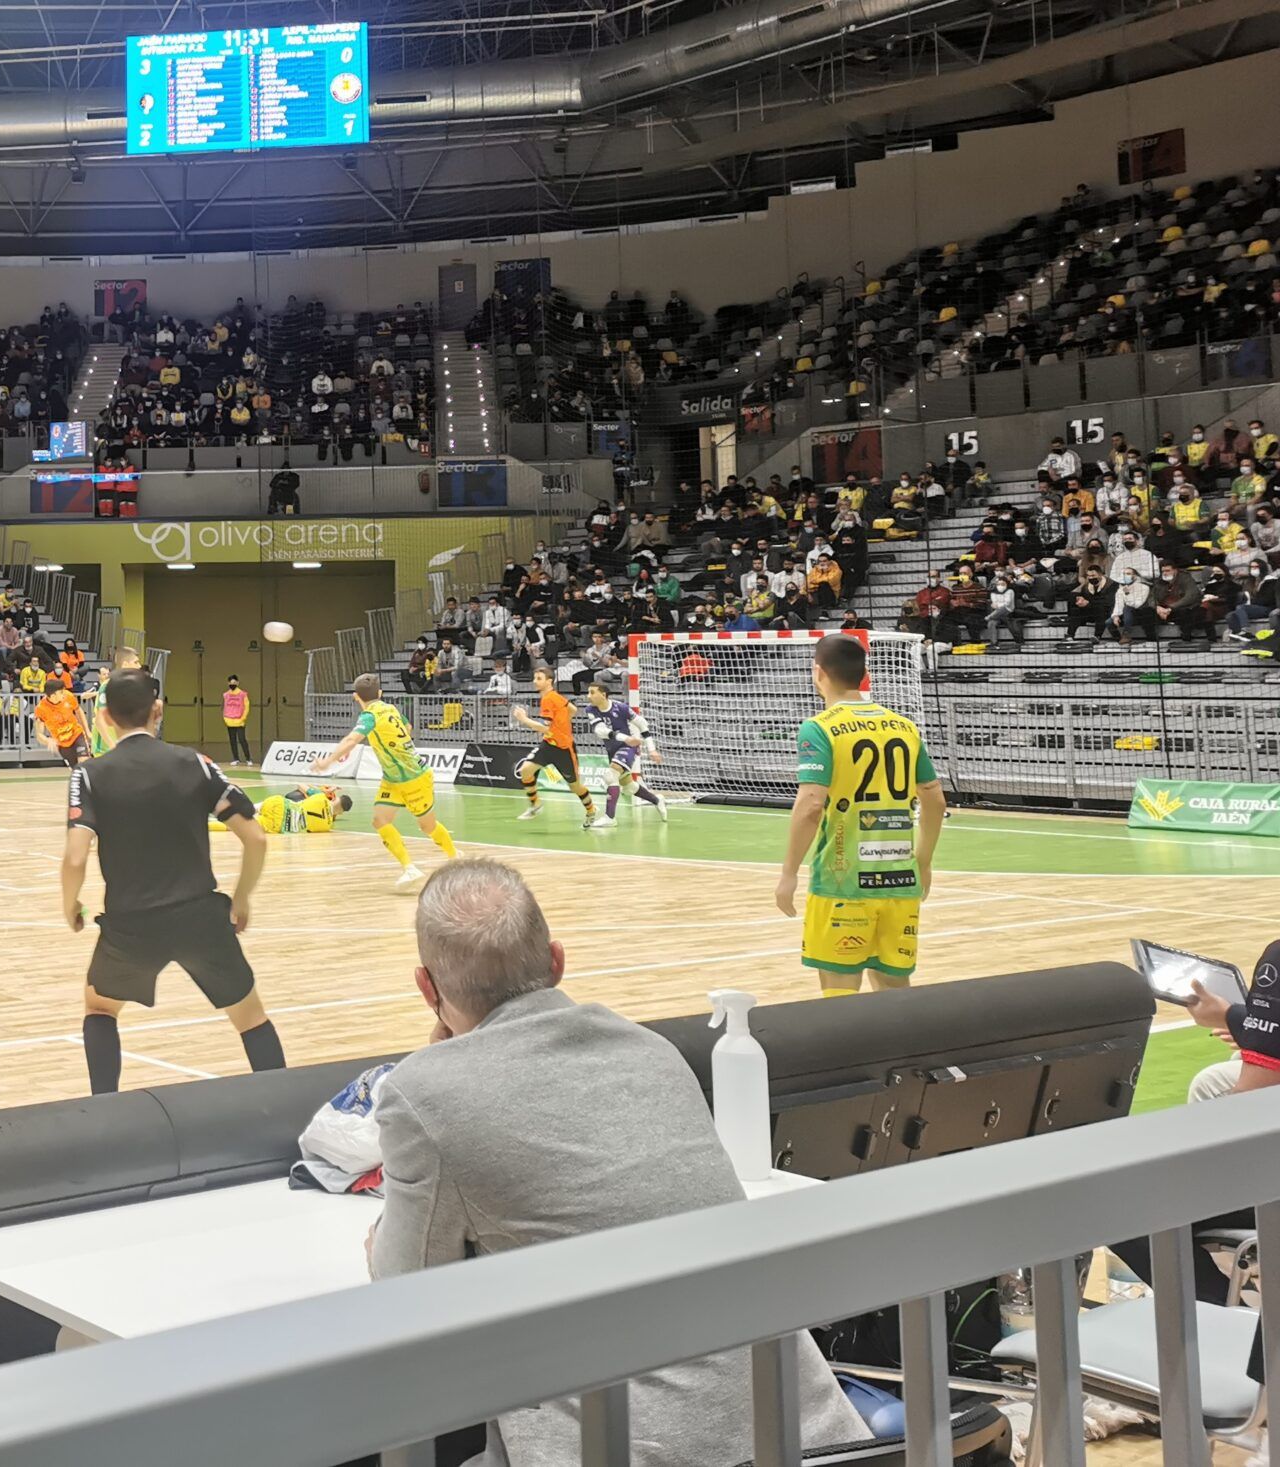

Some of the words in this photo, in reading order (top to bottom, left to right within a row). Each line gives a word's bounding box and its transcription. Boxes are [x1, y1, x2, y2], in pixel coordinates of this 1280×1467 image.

[223, 28, 269, 47] 11:31
[340, 46, 353, 64] 0
[139, 59, 151, 76] 3
[343, 119, 355, 136] 1
[138, 130, 151, 147] 2
[494, 261, 530, 272] Sector
[94, 280, 128, 290] Sector
[681, 394, 732, 416] Salida
[740, 404, 765, 415] Sector
[593, 423, 620, 431] Sector
[1070, 417, 1105, 445] 15
[810, 431, 856, 446] Sector
[947, 430, 979, 456] 15
[436, 461, 480, 473] Sector
[198, 521, 273, 548] olivo
[285, 522, 384, 545] arena
[337, 549, 384, 559] INTERIOR
[830, 720, 877, 737] BRUNO
[274, 745, 333, 766] cajasu
[852, 737, 910, 803] 20
[1188, 797, 1225, 809] CAJA
[1227, 799, 1280, 811] RURAL
[1210, 811, 1251, 824] JAÉN
